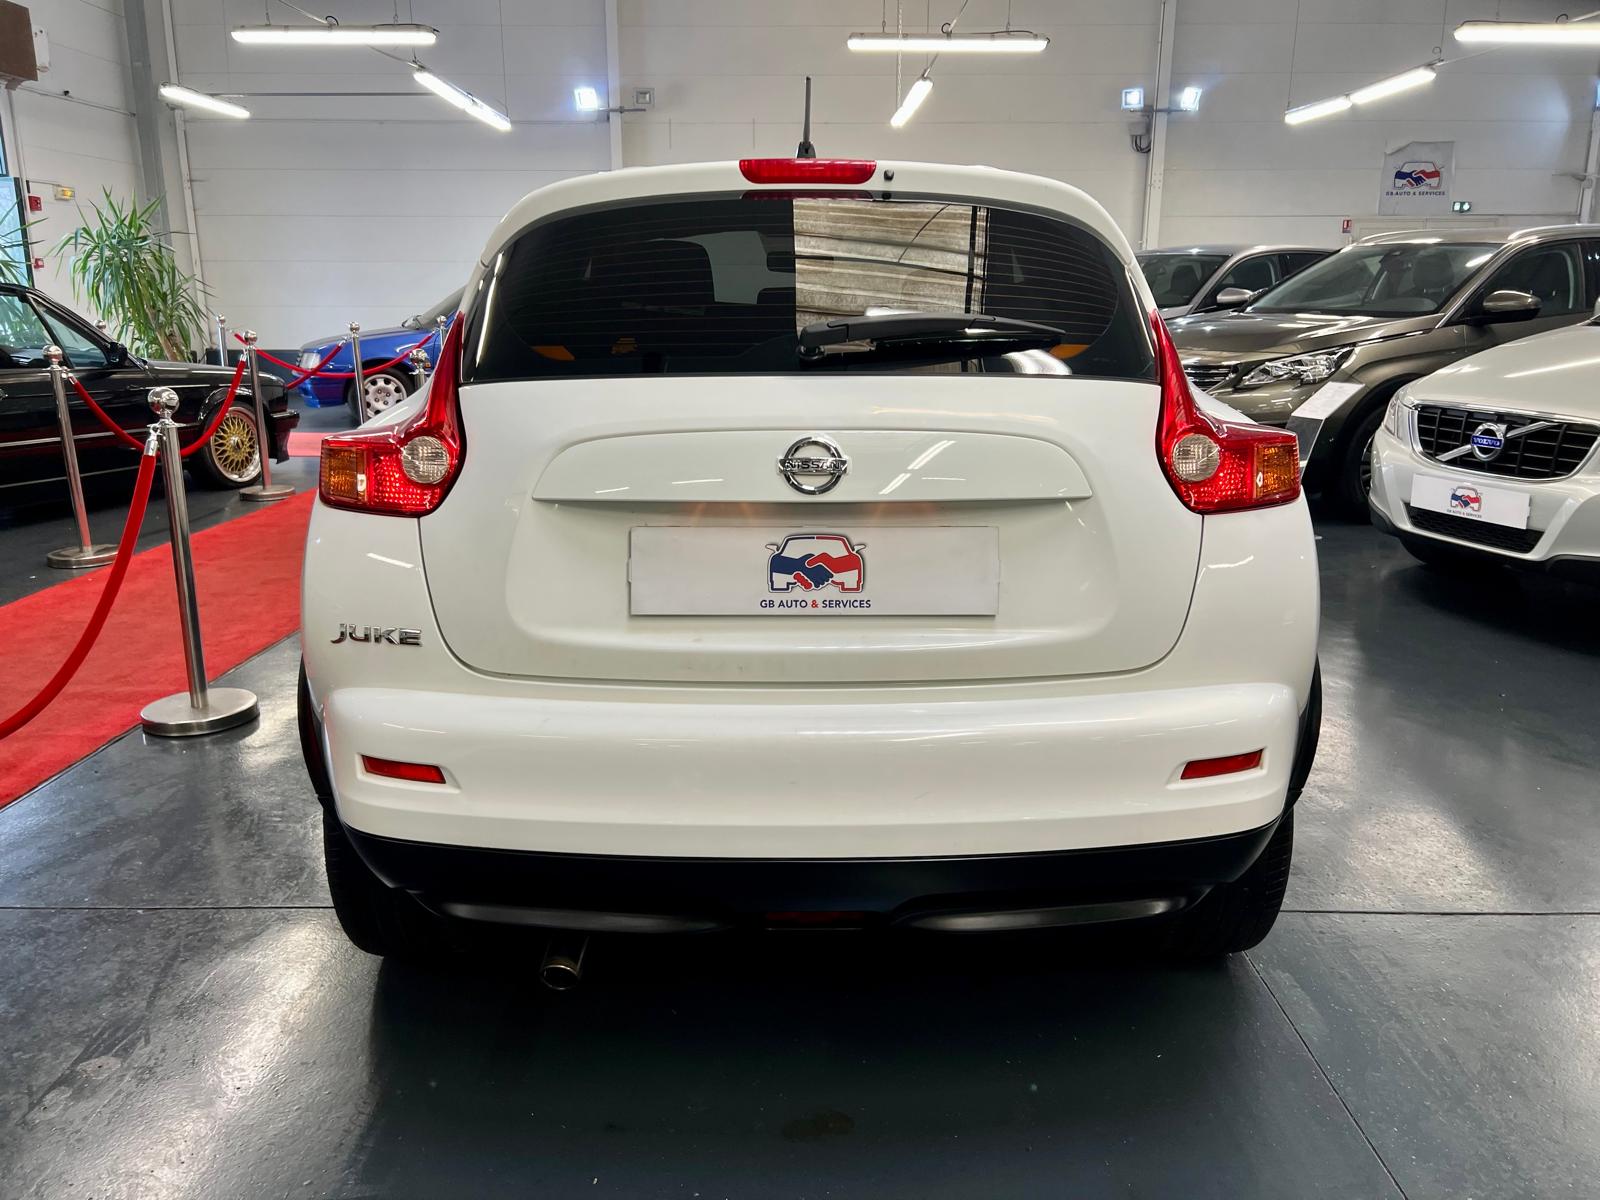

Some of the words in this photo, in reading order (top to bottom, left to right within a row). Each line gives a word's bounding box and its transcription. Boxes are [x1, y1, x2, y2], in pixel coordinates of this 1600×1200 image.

[1473, 437, 1500, 446] VOLVO
[785, 460, 840, 470] NISSAN
[760, 599, 775, 608] GB
[778, 599, 808, 608] AUTO
[810, 599, 819, 608] &
[821, 599, 872, 608] SERVICES
[330, 623, 422, 647] JUKE
